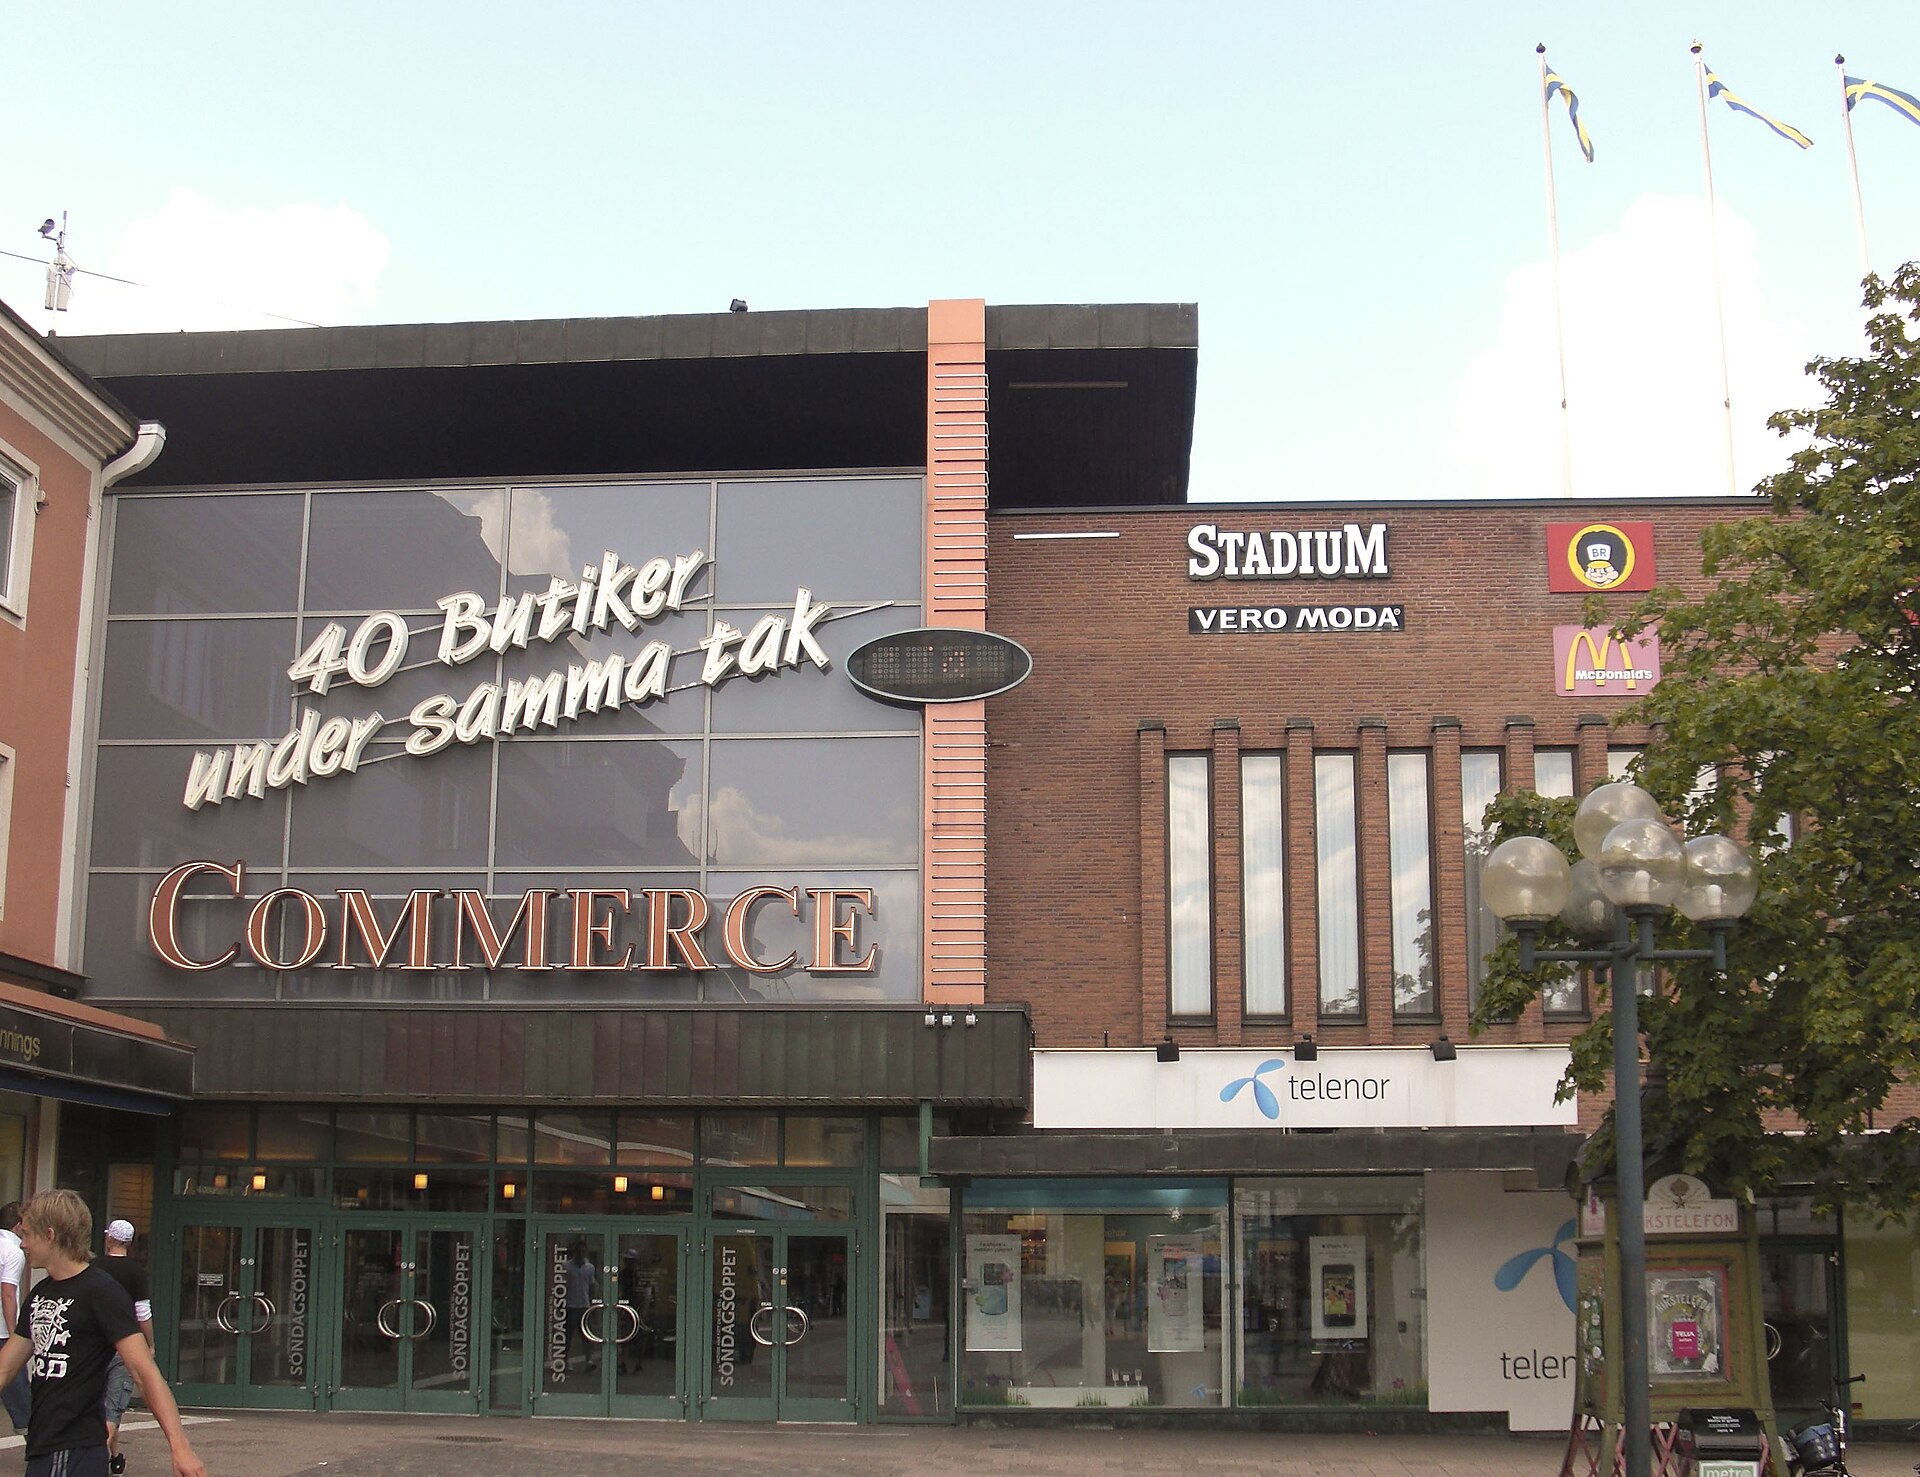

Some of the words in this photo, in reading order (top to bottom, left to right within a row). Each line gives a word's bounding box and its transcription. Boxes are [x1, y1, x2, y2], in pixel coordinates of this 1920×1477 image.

[1187, 523, 1390, 578] STADIUM
[1592, 548, 1607, 559] BR
[287, 611, 409, 696] 40
[436, 547, 708, 667] Butiker
[1195, 608, 1288, 630] VERO
[1296, 606, 1399, 629] MODA
[182, 707, 387, 811] under
[404, 638, 676, 757] samma
[698, 585, 833, 687] tak
[1575, 668, 1653, 681] McDonald's
[148, 859, 880, 974] COMMERCE
[0, 1028, 40, 1061] nnings
[1288, 1072, 1391, 1100] telenor
[1645, 1213, 1734, 1229] KSTELEFON
[289, 1239, 308, 1377] SÖNDAGSÖPPET
[452, 1241, 470, 1379] SÖNDAGSÖPPET
[551, 1244, 568, 1384] SÖNDAGSÖPPET
[719, 1246, 737, 1388] SÖNDAGSÖPPET
[1500, 1349, 1576, 1379] telen
